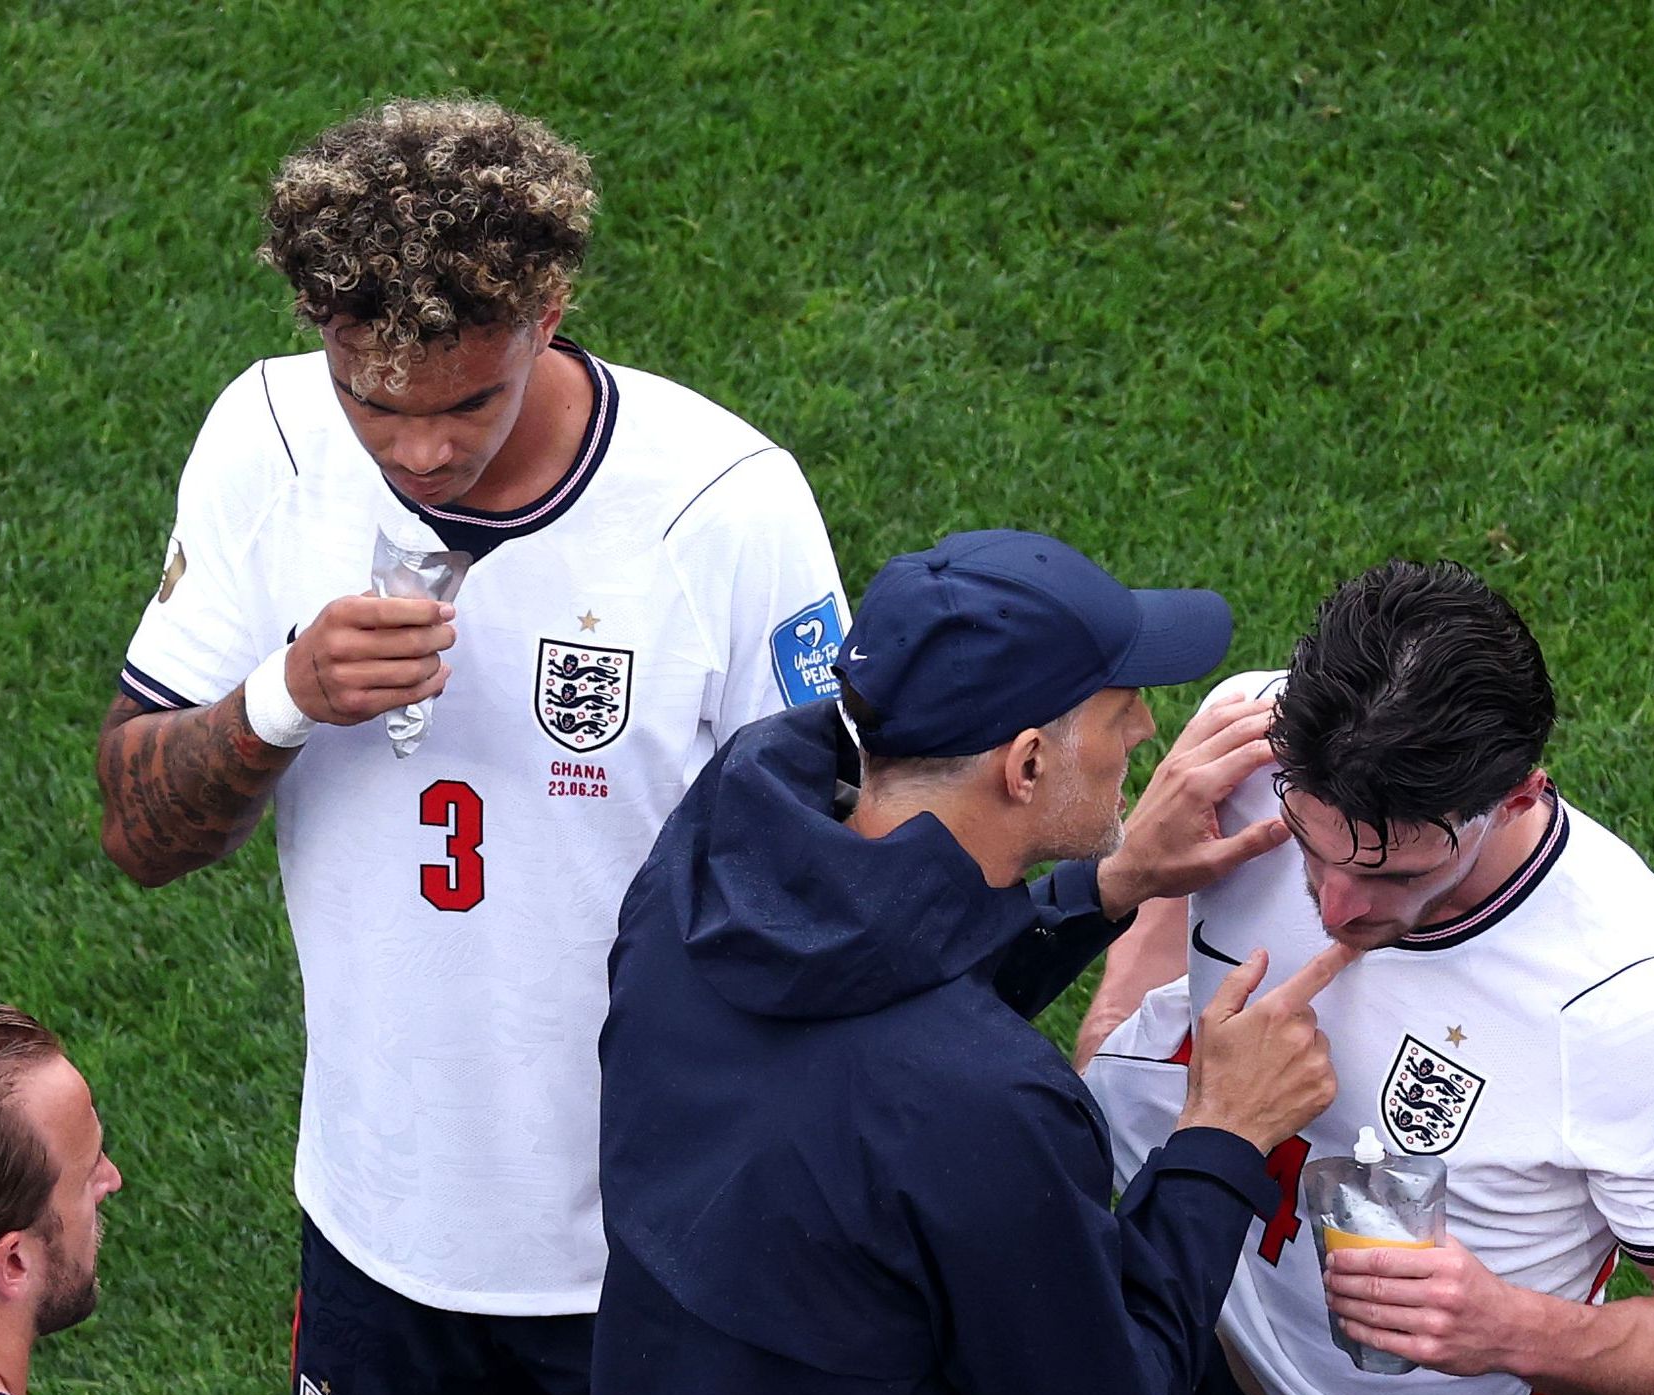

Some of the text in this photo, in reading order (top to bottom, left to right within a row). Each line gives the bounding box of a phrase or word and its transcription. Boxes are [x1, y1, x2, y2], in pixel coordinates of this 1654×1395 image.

[551, 761, 607, 781] GHANA
[548, 781, 609, 798] 23.06.26
[420, 779, 485, 912] 3
